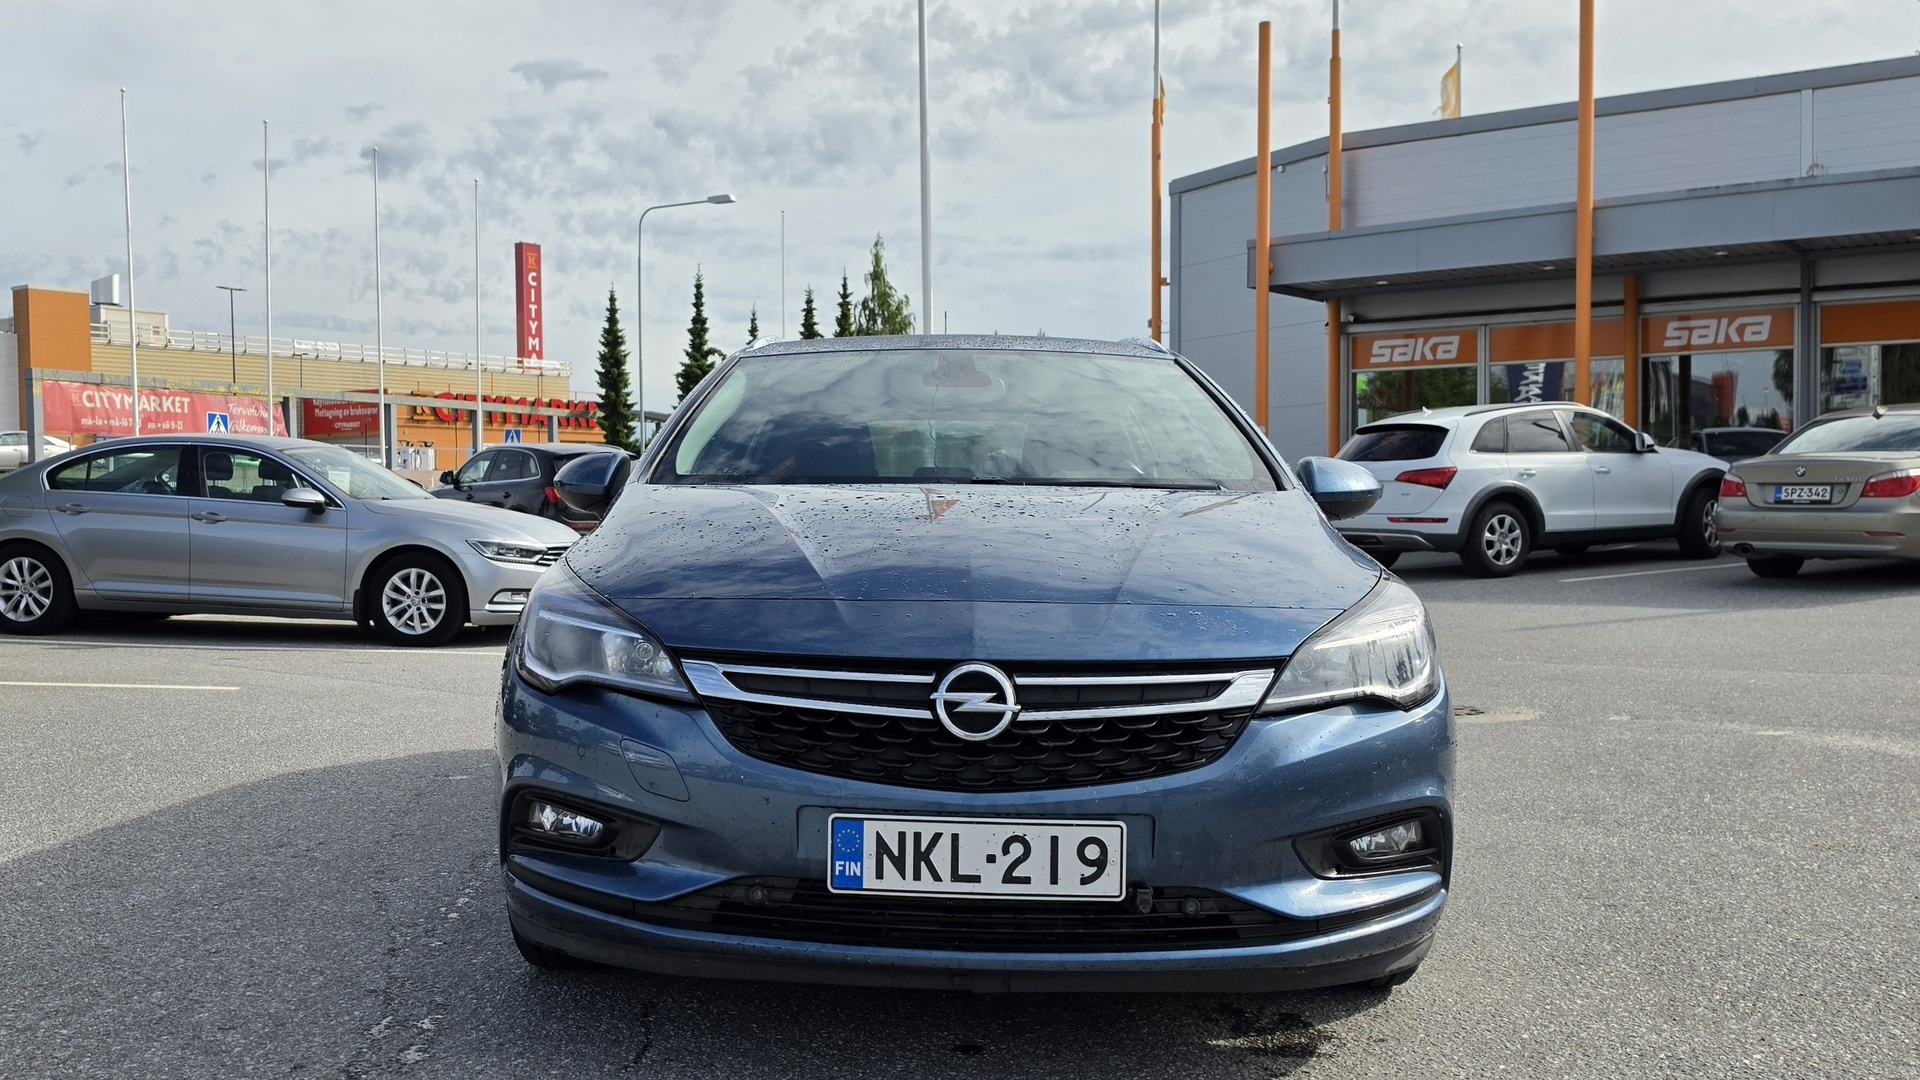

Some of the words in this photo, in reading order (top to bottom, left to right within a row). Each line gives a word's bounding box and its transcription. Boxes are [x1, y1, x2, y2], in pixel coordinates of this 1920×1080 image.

[528, 255, 536, 266] K
[82, 390, 190, 413] CITYMARKET
[334, 421, 361, 429] CITYMARKET
[1783, 487, 1828, 498] SPZ-342
[875, 830, 1109, 886] NKL-219
[835, 860, 861, 877] FIN
